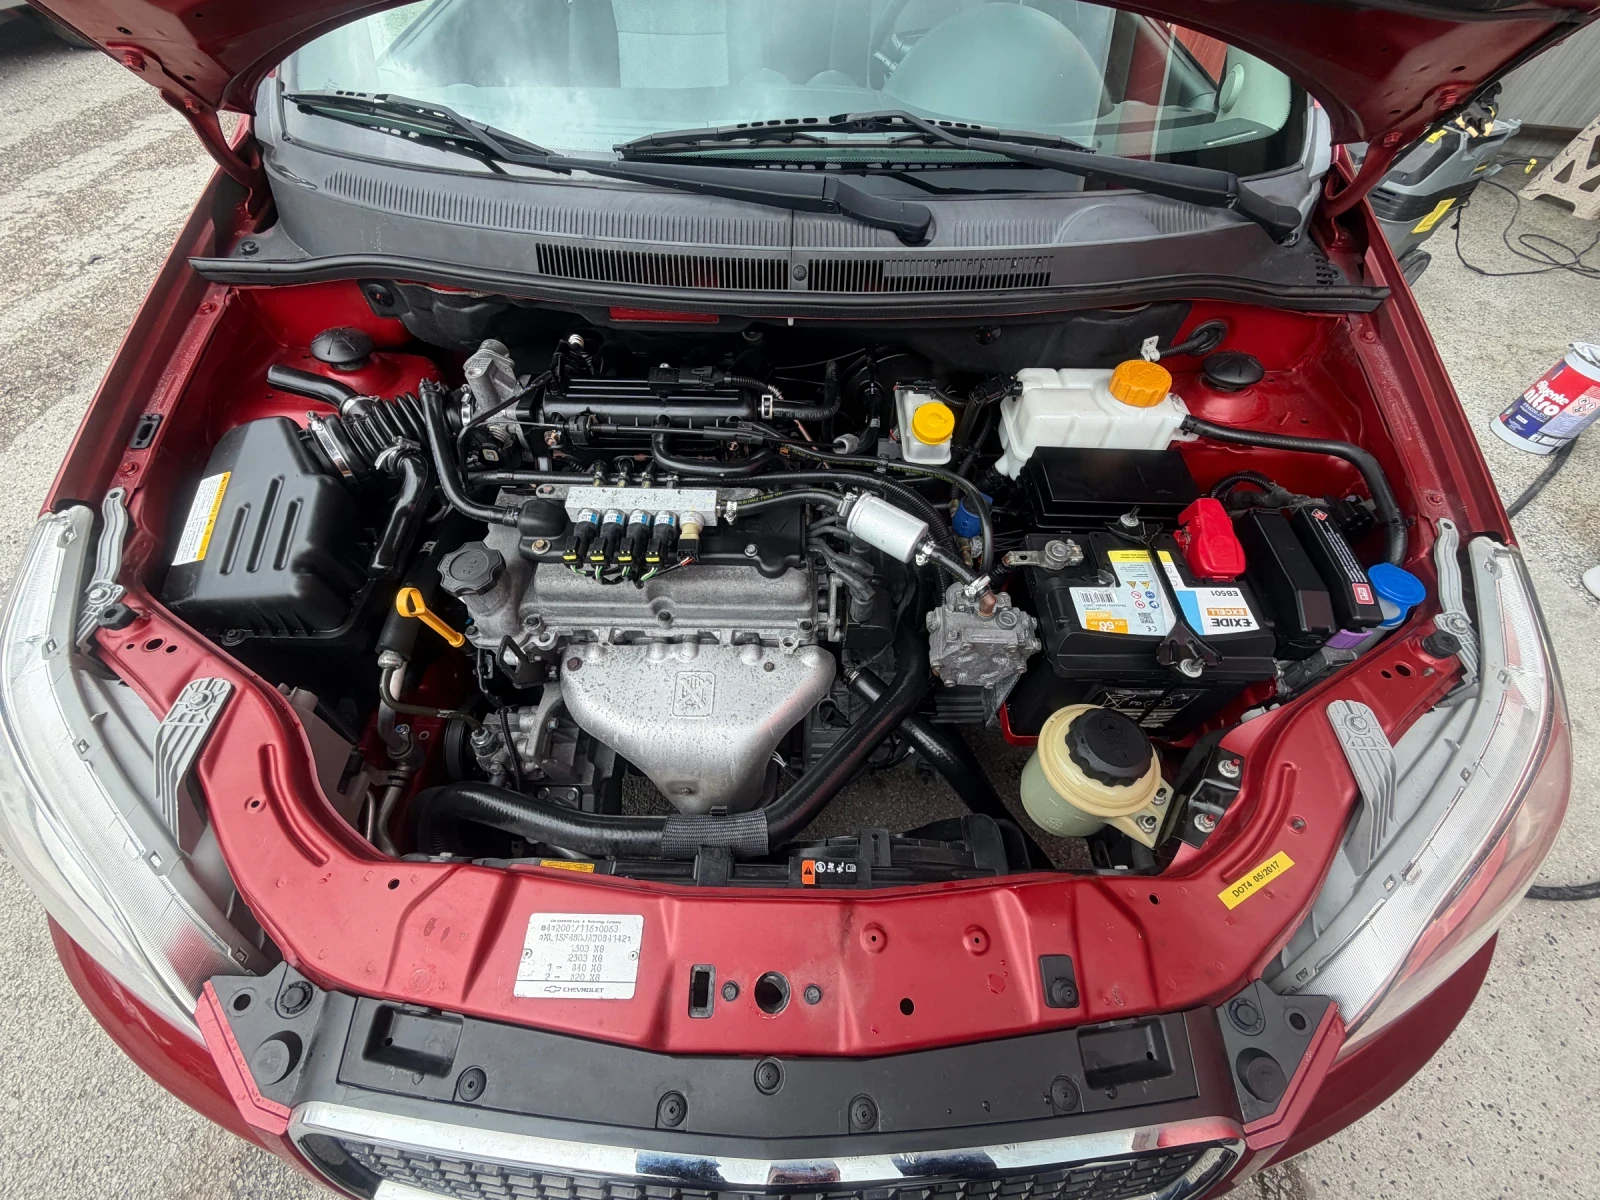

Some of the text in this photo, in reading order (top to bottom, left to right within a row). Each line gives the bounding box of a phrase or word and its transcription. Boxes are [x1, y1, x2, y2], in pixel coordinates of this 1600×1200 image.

[1524, 388, 1560, 416] nitro
[1210, 618, 1252, 627] EXIDE
[1232, 861, 1280, 898] DOT4 05/2017
